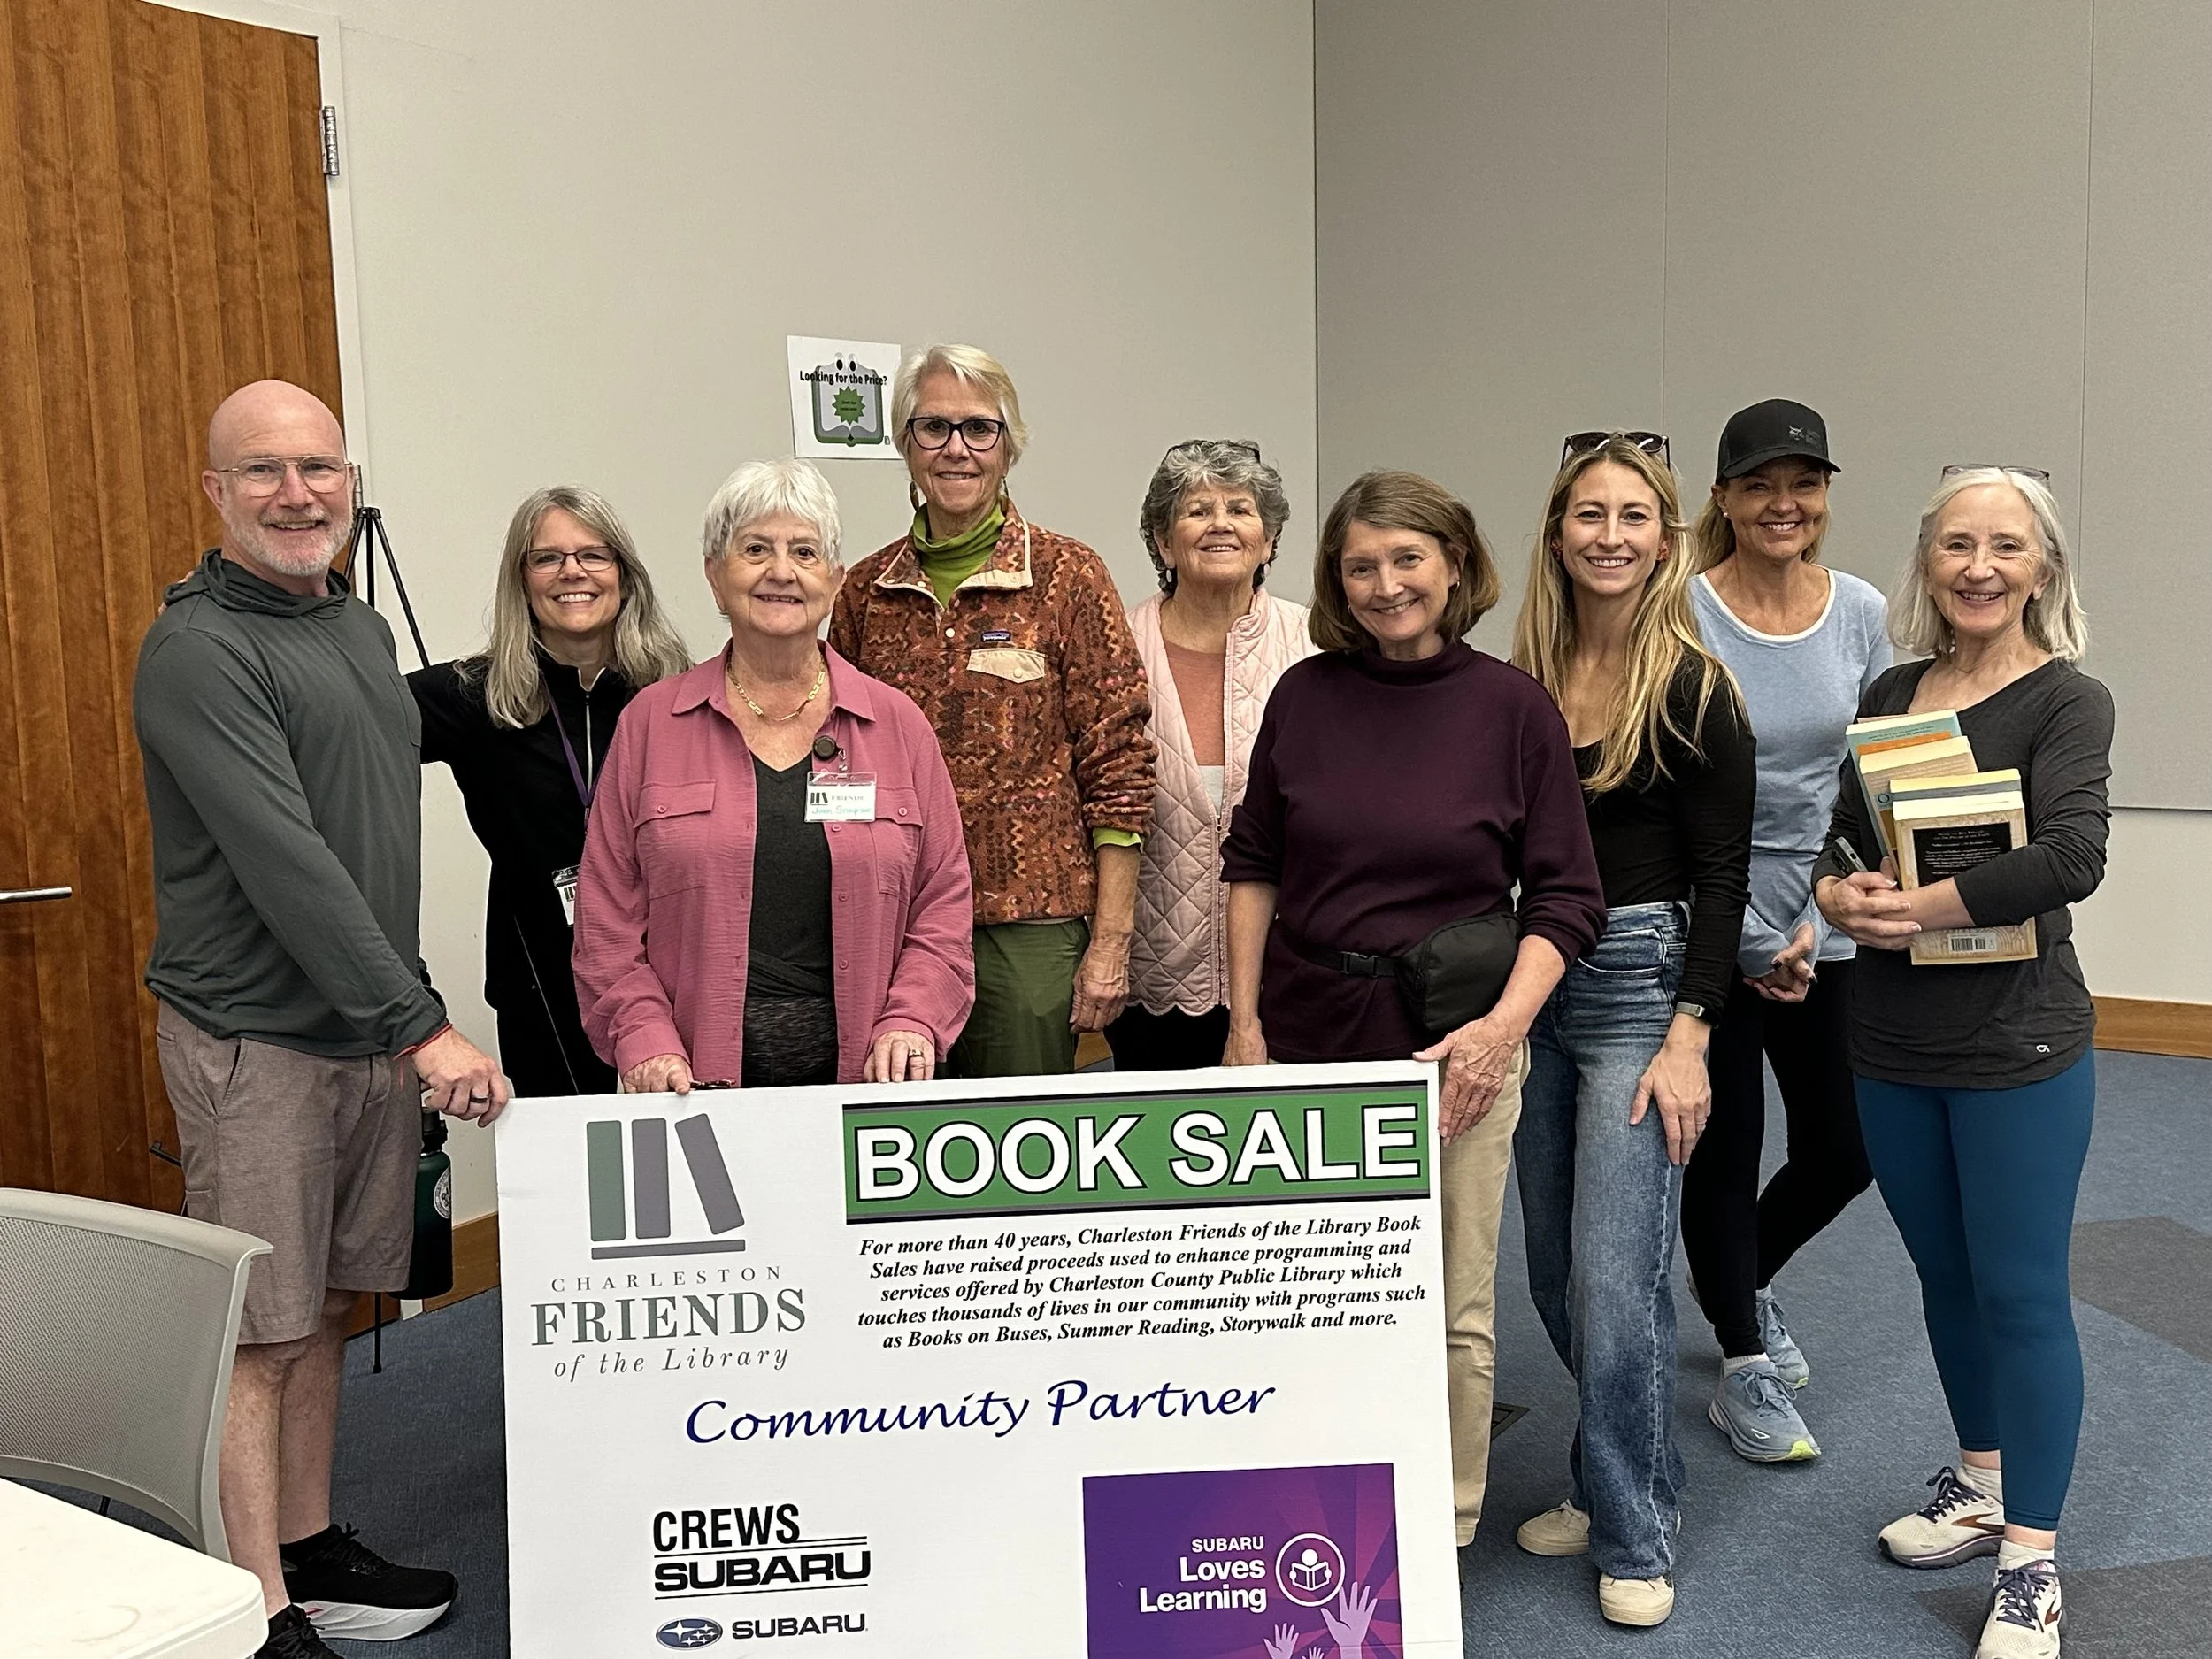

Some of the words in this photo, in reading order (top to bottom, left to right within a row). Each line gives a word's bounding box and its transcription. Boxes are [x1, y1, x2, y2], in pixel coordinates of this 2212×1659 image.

[800, 370, 834, 386] Looking
[834, 372, 848, 384] for
[849, 373, 864, 385] the
[864, 374, 887, 386] Price?
[855, 1113, 1148, 1203] BOOK
[1169, 1103, 1421, 1188] SALE
[859, 1239, 894, 1256] For
[897, 1240, 944, 1254] more
[948, 1234, 988, 1251] than
[994, 1232, 1016, 1248] 40
[1018, 1234, 1071, 1252] years,
[1078, 1226, 1173, 1245] Charleston
[1179, 1222, 1247, 1240] Friends
[1251, 1220, 1273, 1241] of
[1273, 1220, 1302, 1236] the
[1305, 1218, 1371, 1237] Library
[1376, 1215, 1421, 1233] Book
[870, 1261, 918, 1279] Sales
[922, 1259, 965, 1276] have
[969, 1255, 1025, 1273] raised
[1025, 1251, 1105, 1275] proceeds
[1110, 1248, 1151, 1267] used
[1154, 1251, 1171, 1264] to
[1176, 1247, 1250, 1264] enhance
[1252, 1240, 1374, 1265] programming
[1379, 1238, 1412, 1256] and
[551, 1265, 782, 1294] CHARLESTON
[880, 1283, 950, 1302] services
[956, 1278, 1019, 1302] offered
[1023, 1278, 1044, 1298] by
[1049, 1274, 1144, 1293] Charleston
[1151, 1271, 1214, 1291] County
[1218, 1267, 1276, 1286] Public
[1279, 1265, 1346, 1285] Library
[1350, 1262, 1402, 1279] which
[530, 1288, 806, 1347] FRIENDS
[857, 1308, 927, 1326] touches
[931, 1302, 1022, 1322] thousands
[1026, 1300, 1049, 1322] of
[1049, 1300, 1089, 1317] lives
[1094, 1298, 1111, 1314] in
[1117, 1301, 1148, 1313] our
[1153, 1292, 1251, 1312] community
[1256, 1290, 1292, 1307] with
[1295, 1291, 1381, 1310] programs
[1385, 1284, 1425, 1302] such
[882, 1336, 902, 1348] as
[907, 1328, 963, 1347] Books
[967, 1332, 990, 1344] on
[995, 1325, 1052, 1343] Buses,
[1057, 1323, 1133, 1340] Summer
[1137, 1317, 1215, 1338] Reading,
[1219, 1312, 1306, 1335] Storywalk
[1310, 1310, 1345, 1328] and
[1348, 1313, 1397, 1326] more.
[554, 1352, 587, 1383] of
[599, 1351, 644, 1374] the
[662, 1346, 789, 1371] Library
[686, 1391, 1030, 1443] Community
[1048, 1379, 1276, 1426] Partner
[653, 1503, 800, 1552] CREWS
[1191, 1536, 1264, 1553] SUBARU
[655, 1550, 871, 1592] SUBARU
[1179, 1556, 1266, 1582] Loves
[1140, 1583, 1267, 1614] Learning
[732, 1613, 865, 1640] SUBARU
